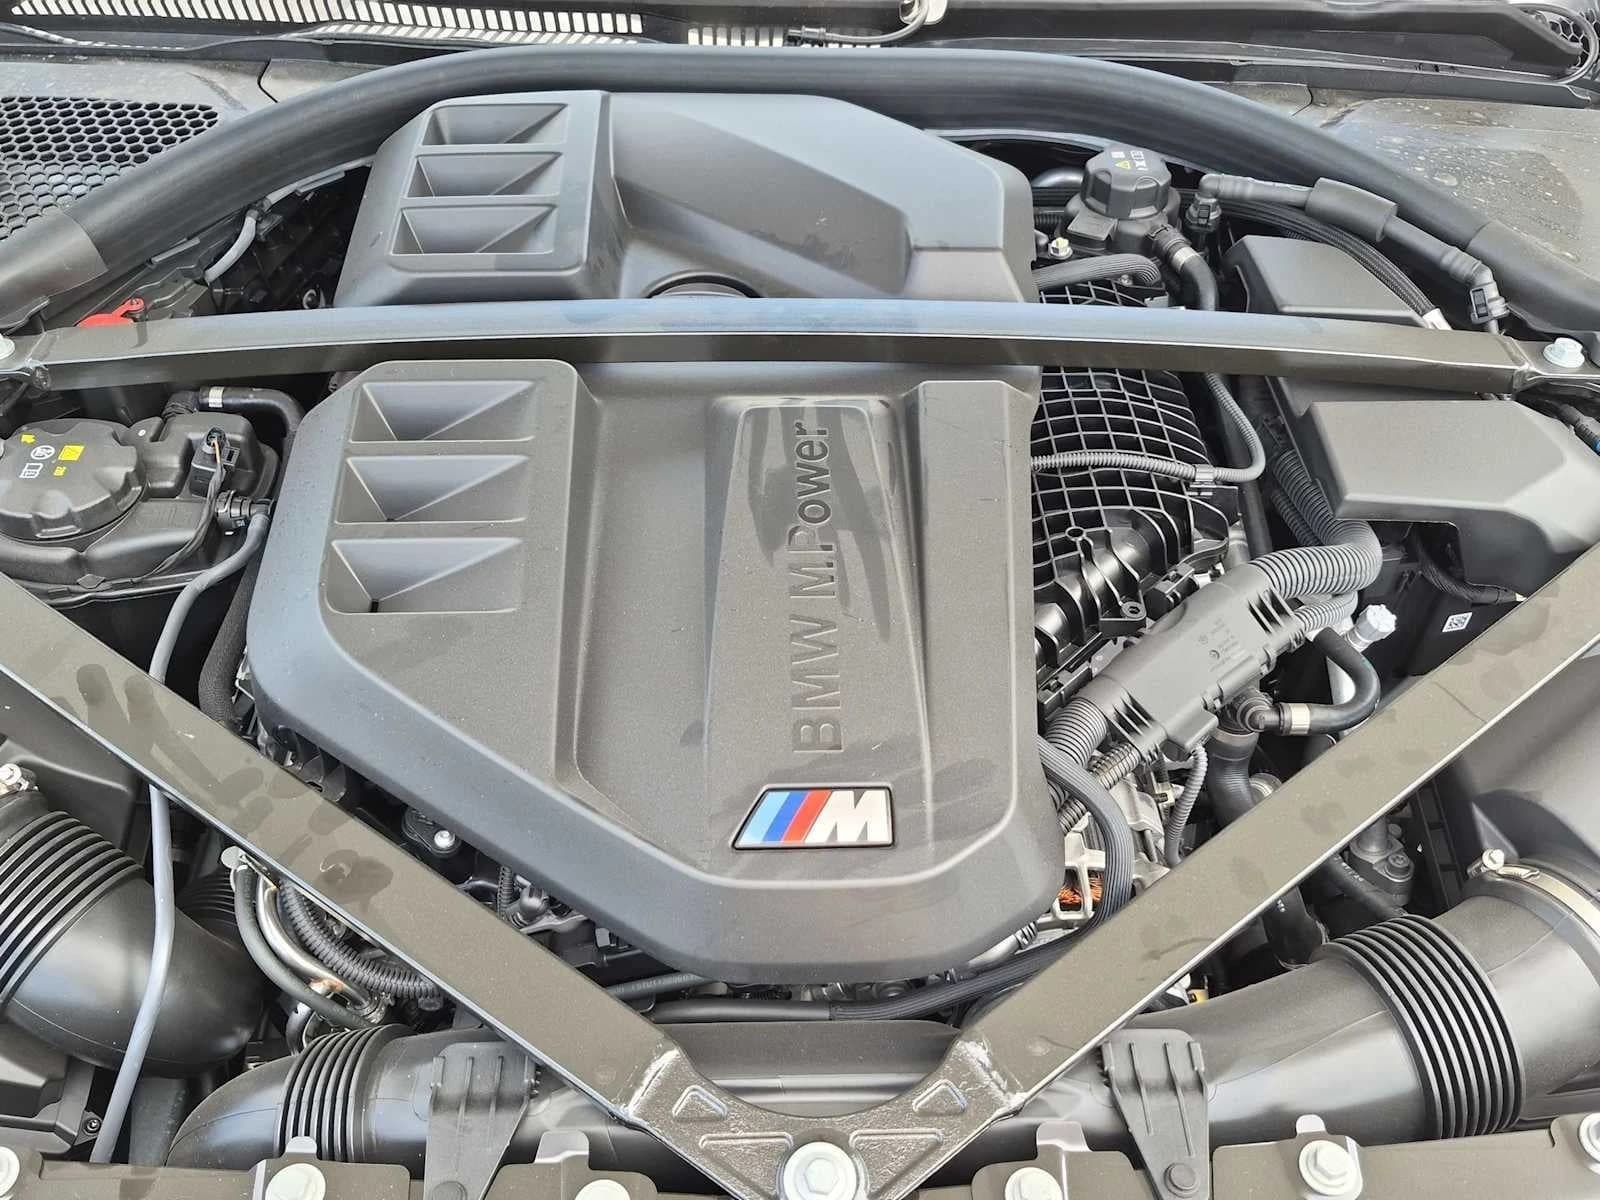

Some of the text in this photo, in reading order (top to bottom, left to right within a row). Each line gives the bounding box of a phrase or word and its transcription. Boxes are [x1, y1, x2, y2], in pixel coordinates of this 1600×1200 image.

[787, 420, 835, 554] Power
[788, 613, 844, 753] BMW
[803, 789, 893, 843] M
